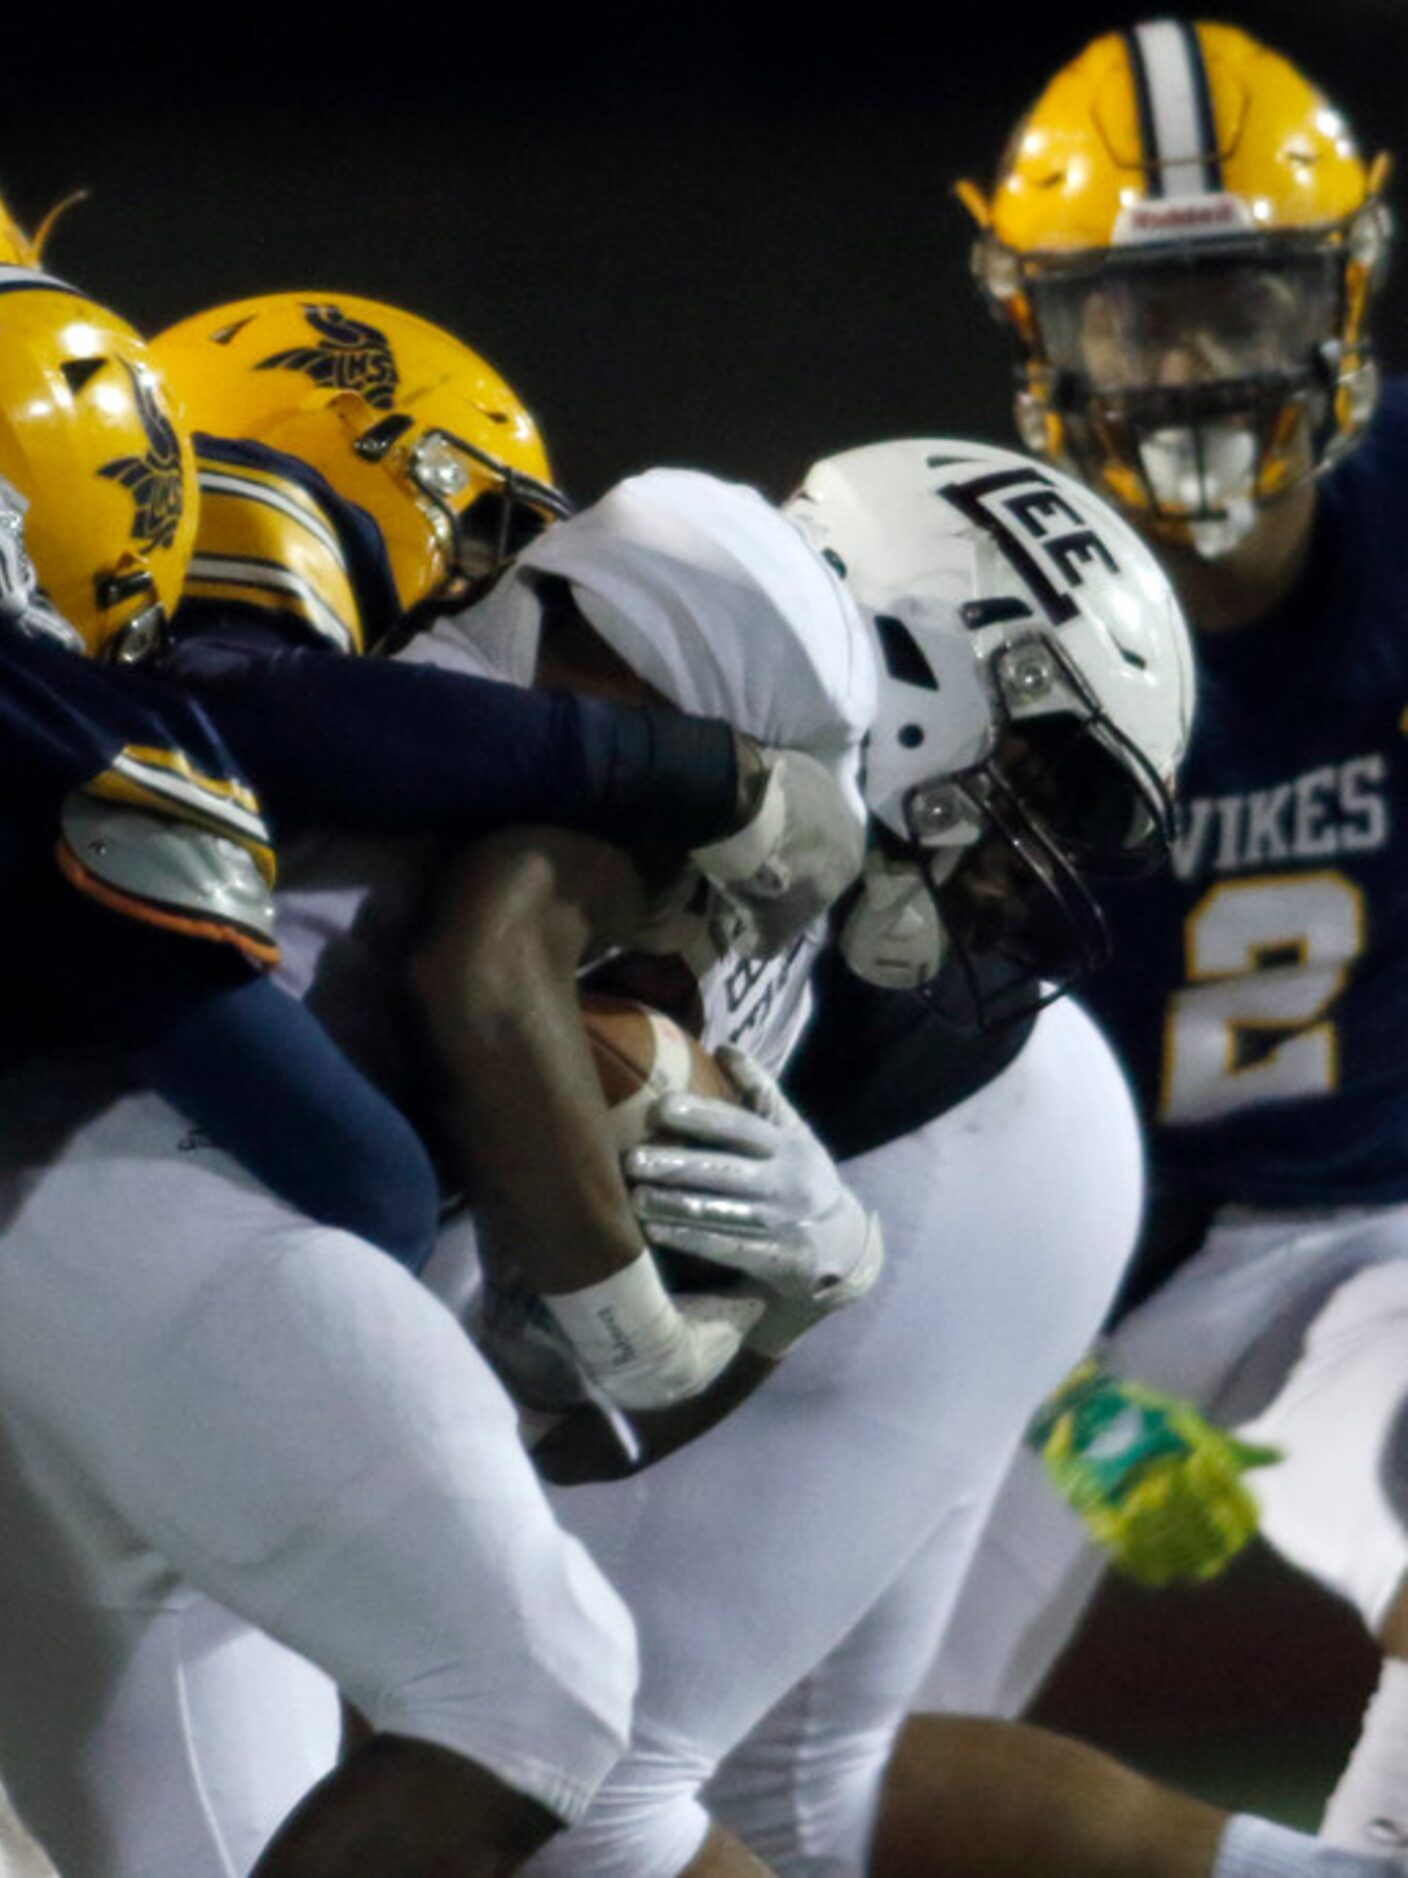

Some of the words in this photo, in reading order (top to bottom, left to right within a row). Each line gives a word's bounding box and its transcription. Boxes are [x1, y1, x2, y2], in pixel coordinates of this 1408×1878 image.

[936, 467, 1121, 627] LEE
[1167, 754, 1388, 880] VIKES
[1158, 869, 1367, 1126] 2
